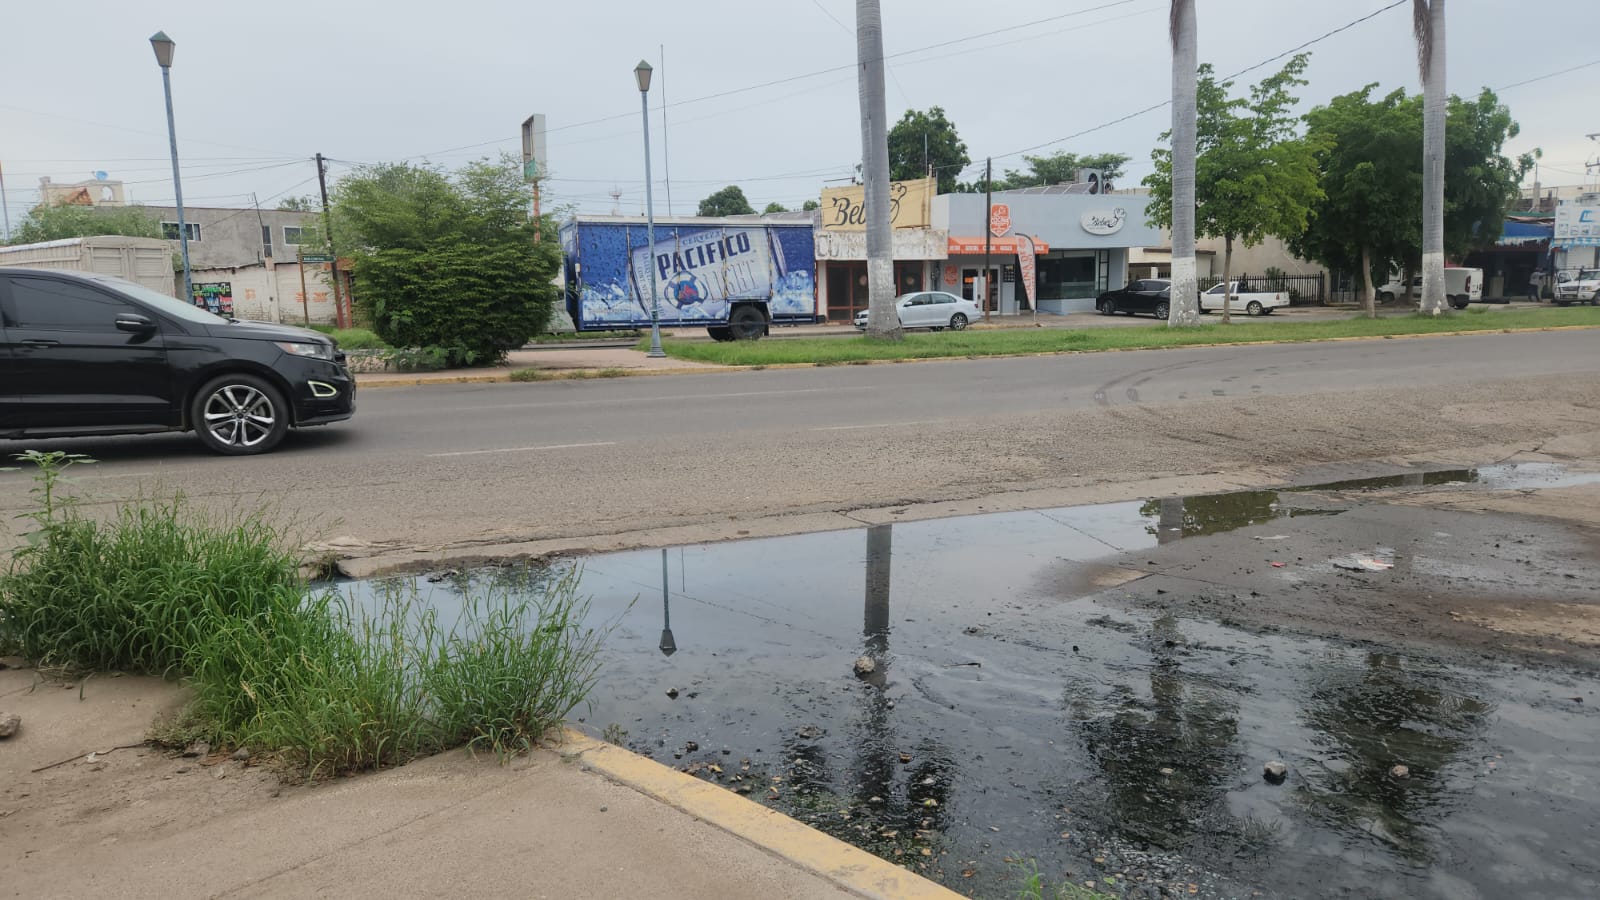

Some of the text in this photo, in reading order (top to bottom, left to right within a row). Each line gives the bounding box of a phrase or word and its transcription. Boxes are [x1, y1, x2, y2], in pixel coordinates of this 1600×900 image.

[656, 232, 751, 281] PACIFICO
[682, 231, 722, 246] CERVEZA
[702, 260, 760, 304] LIGHT
